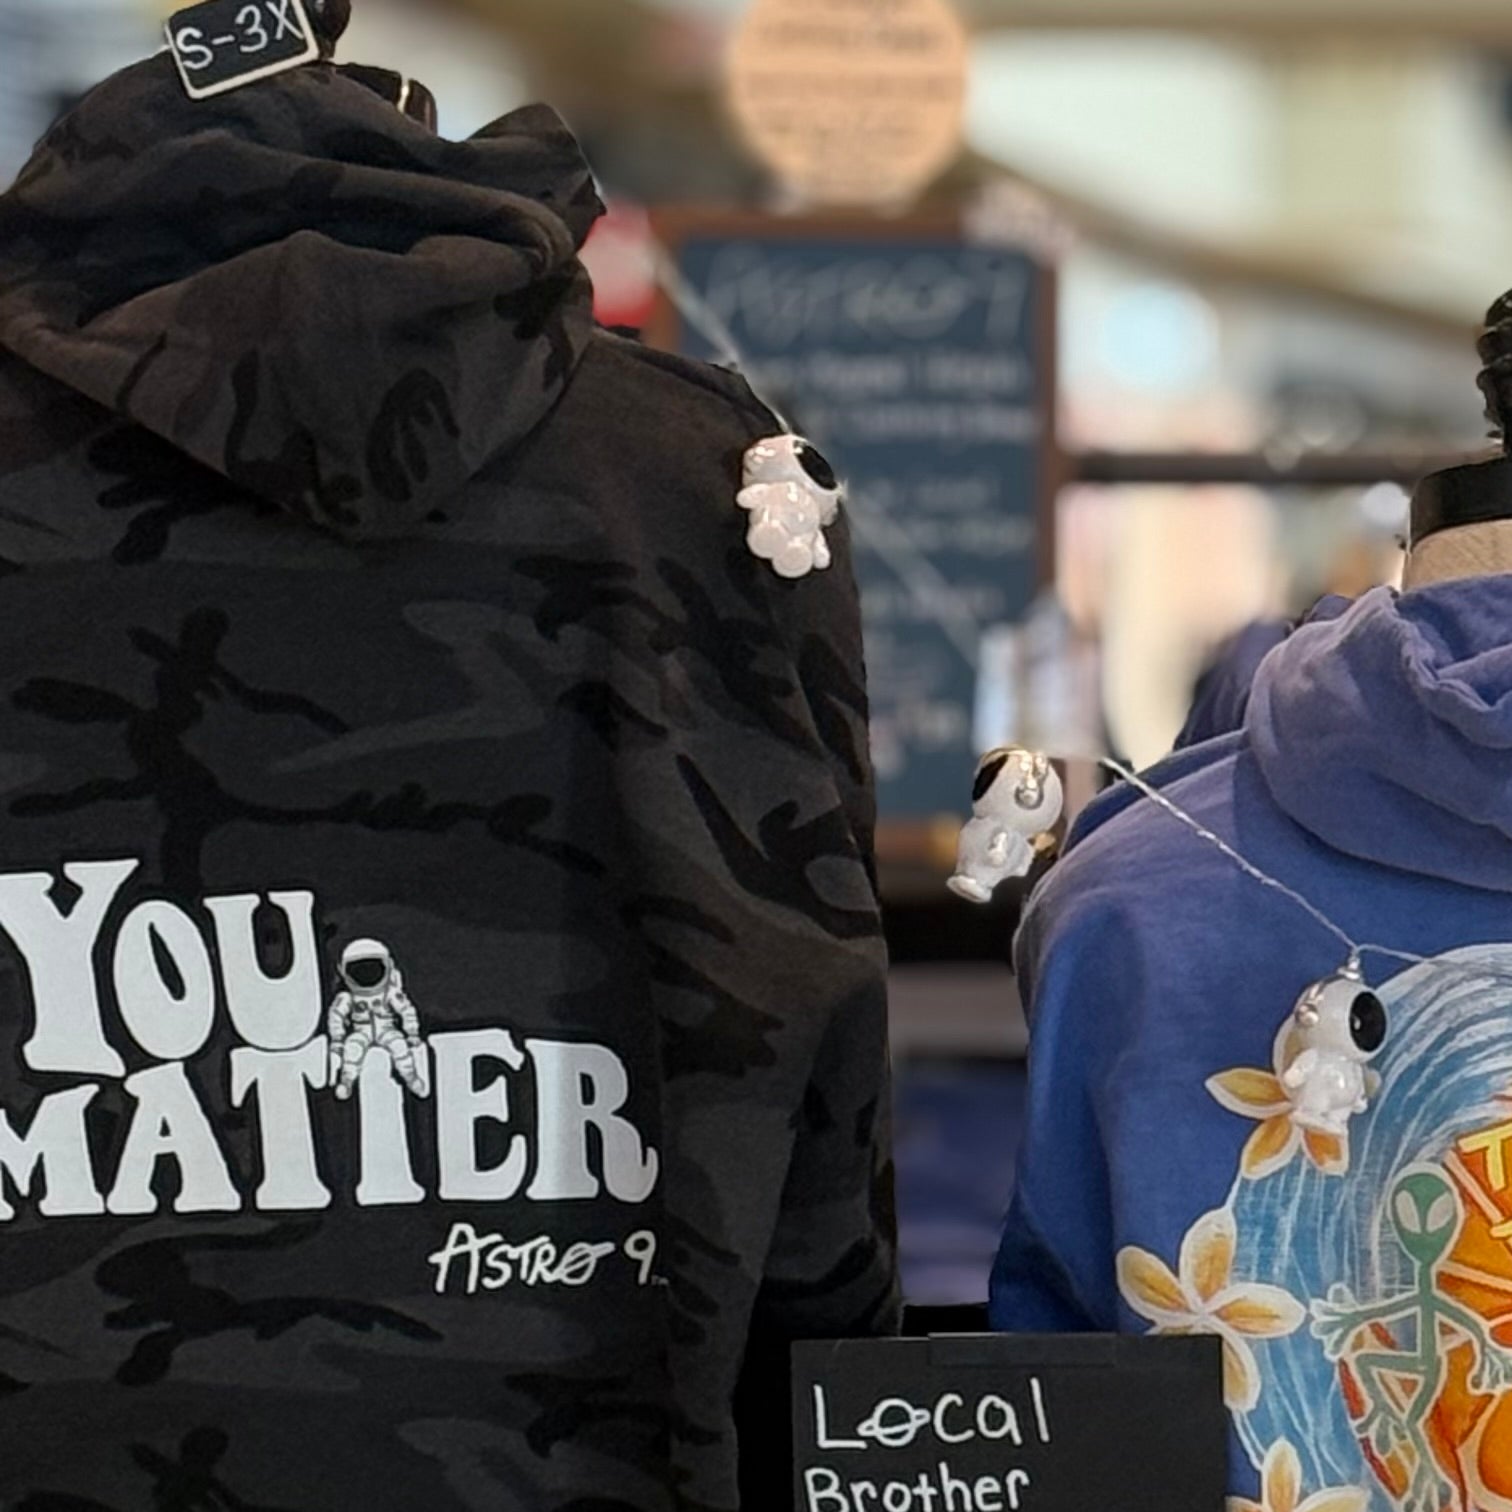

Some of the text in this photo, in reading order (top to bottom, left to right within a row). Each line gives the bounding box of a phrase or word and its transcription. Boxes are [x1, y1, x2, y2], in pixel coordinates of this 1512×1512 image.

[175, 0, 305, 70] S-3X
[0, 858, 322, 1077] YOU
[0, 1029, 658, 1221] MATTER
[624, 1230, 656, 1285] 9
[814, 1378, 1050, 1450] Local
